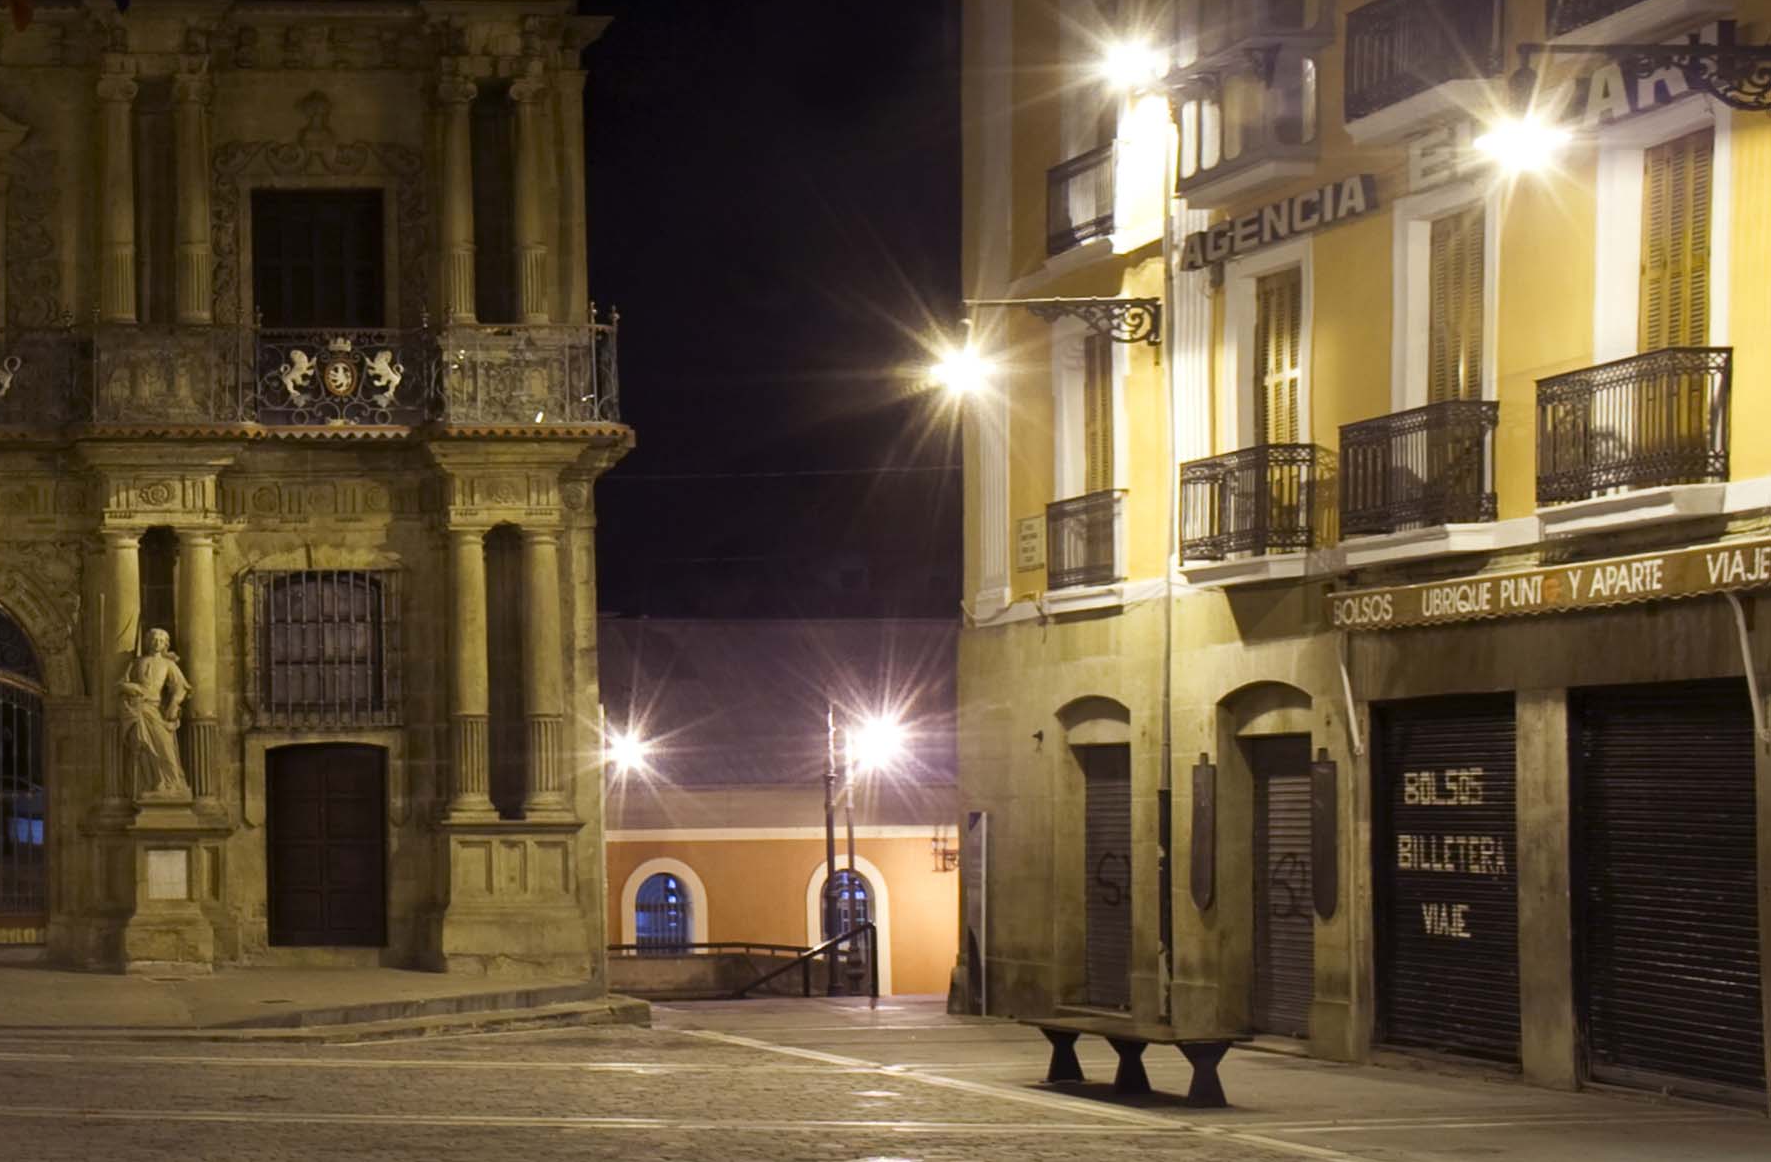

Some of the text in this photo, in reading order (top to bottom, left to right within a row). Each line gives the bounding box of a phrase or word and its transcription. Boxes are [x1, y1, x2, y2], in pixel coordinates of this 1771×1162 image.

[1181, 175, 1366, 271] AGENCIA
[1333, 594, 1393, 626] BOLSOS
[1422, 581, 1492, 616] UBRIQUE
[1567, 569, 1582, 600] Y
[1589, 560, 1663, 598] APARTE
[1403, 767, 1484, 806] BOLSOS
[1396, 834, 1508, 875] BILLETERA
[1421, 902, 1472, 938] VIAJE
